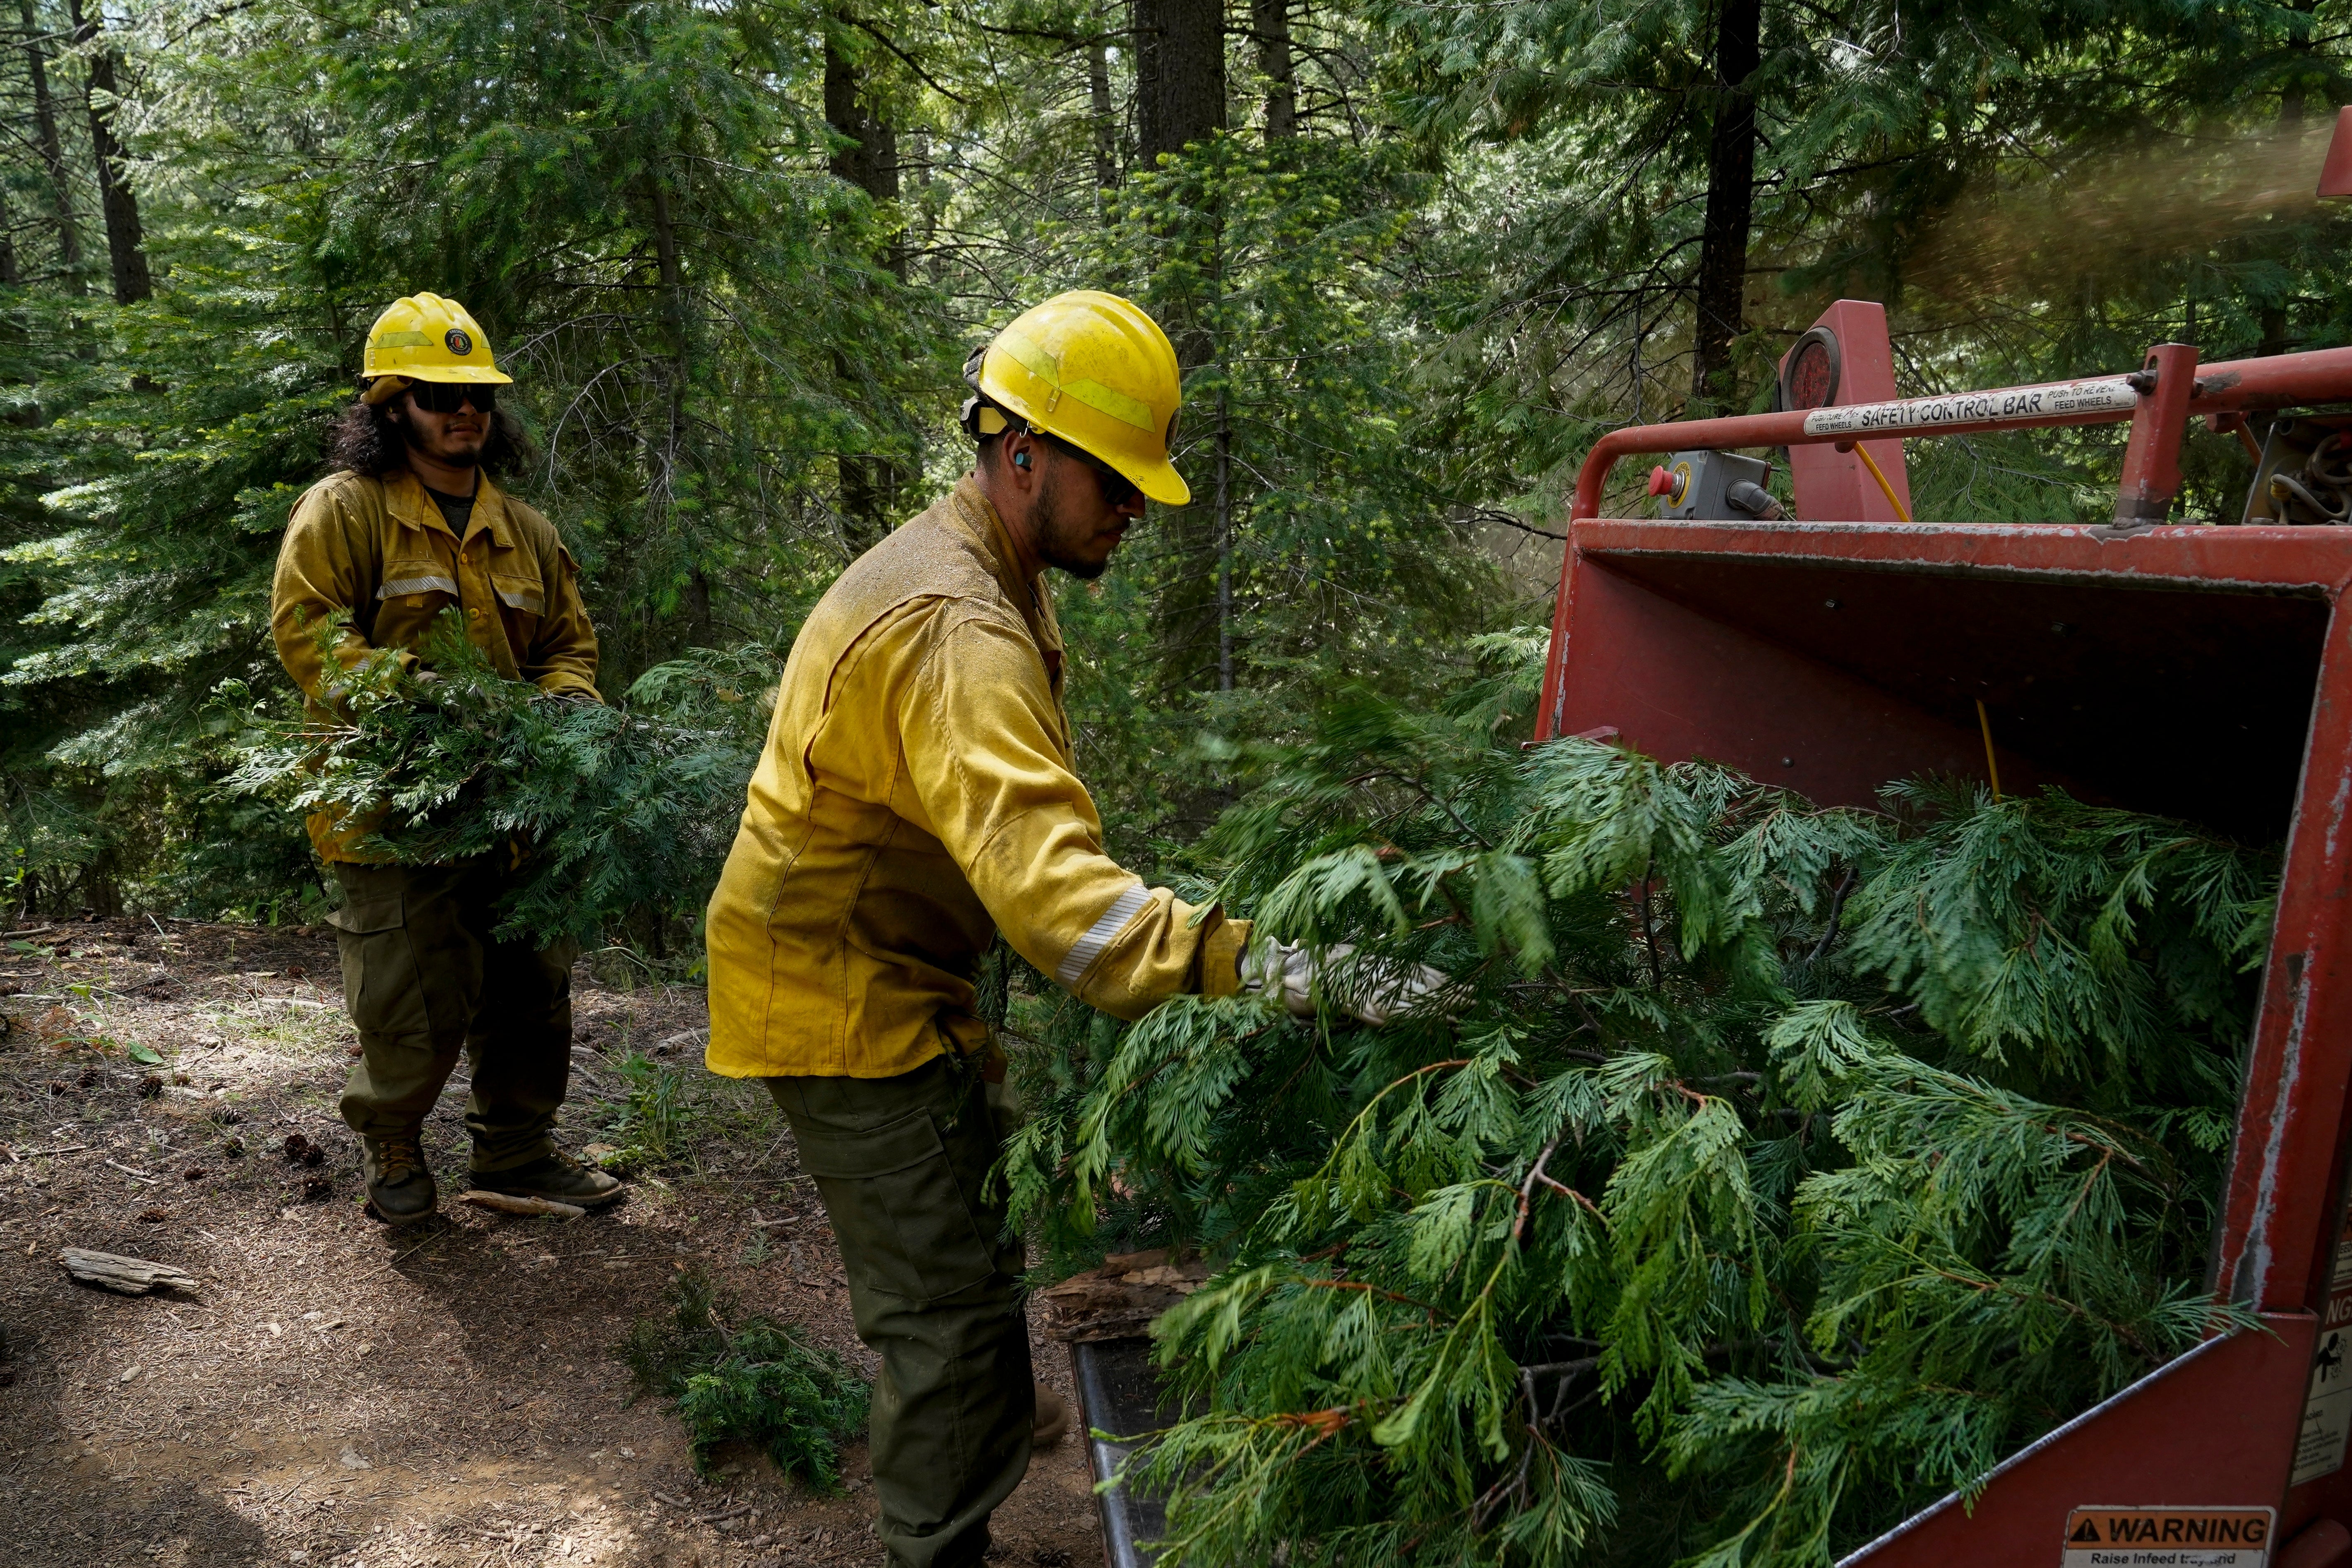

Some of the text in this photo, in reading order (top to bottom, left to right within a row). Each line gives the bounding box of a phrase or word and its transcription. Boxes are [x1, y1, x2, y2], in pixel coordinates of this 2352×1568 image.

[2071, 388, 2082, 396] TO
[1862, 394, 2042, 426] SAFETY CONTROL BAR
[2055, 399, 2075, 410] FEED
[2077, 396, 2111, 407] WHEELS
[2109, 1518, 2266, 1542] WARNING
[2090, 1553, 2129, 1564] Raise
[2133, 1553, 2176, 1564] Infeed
